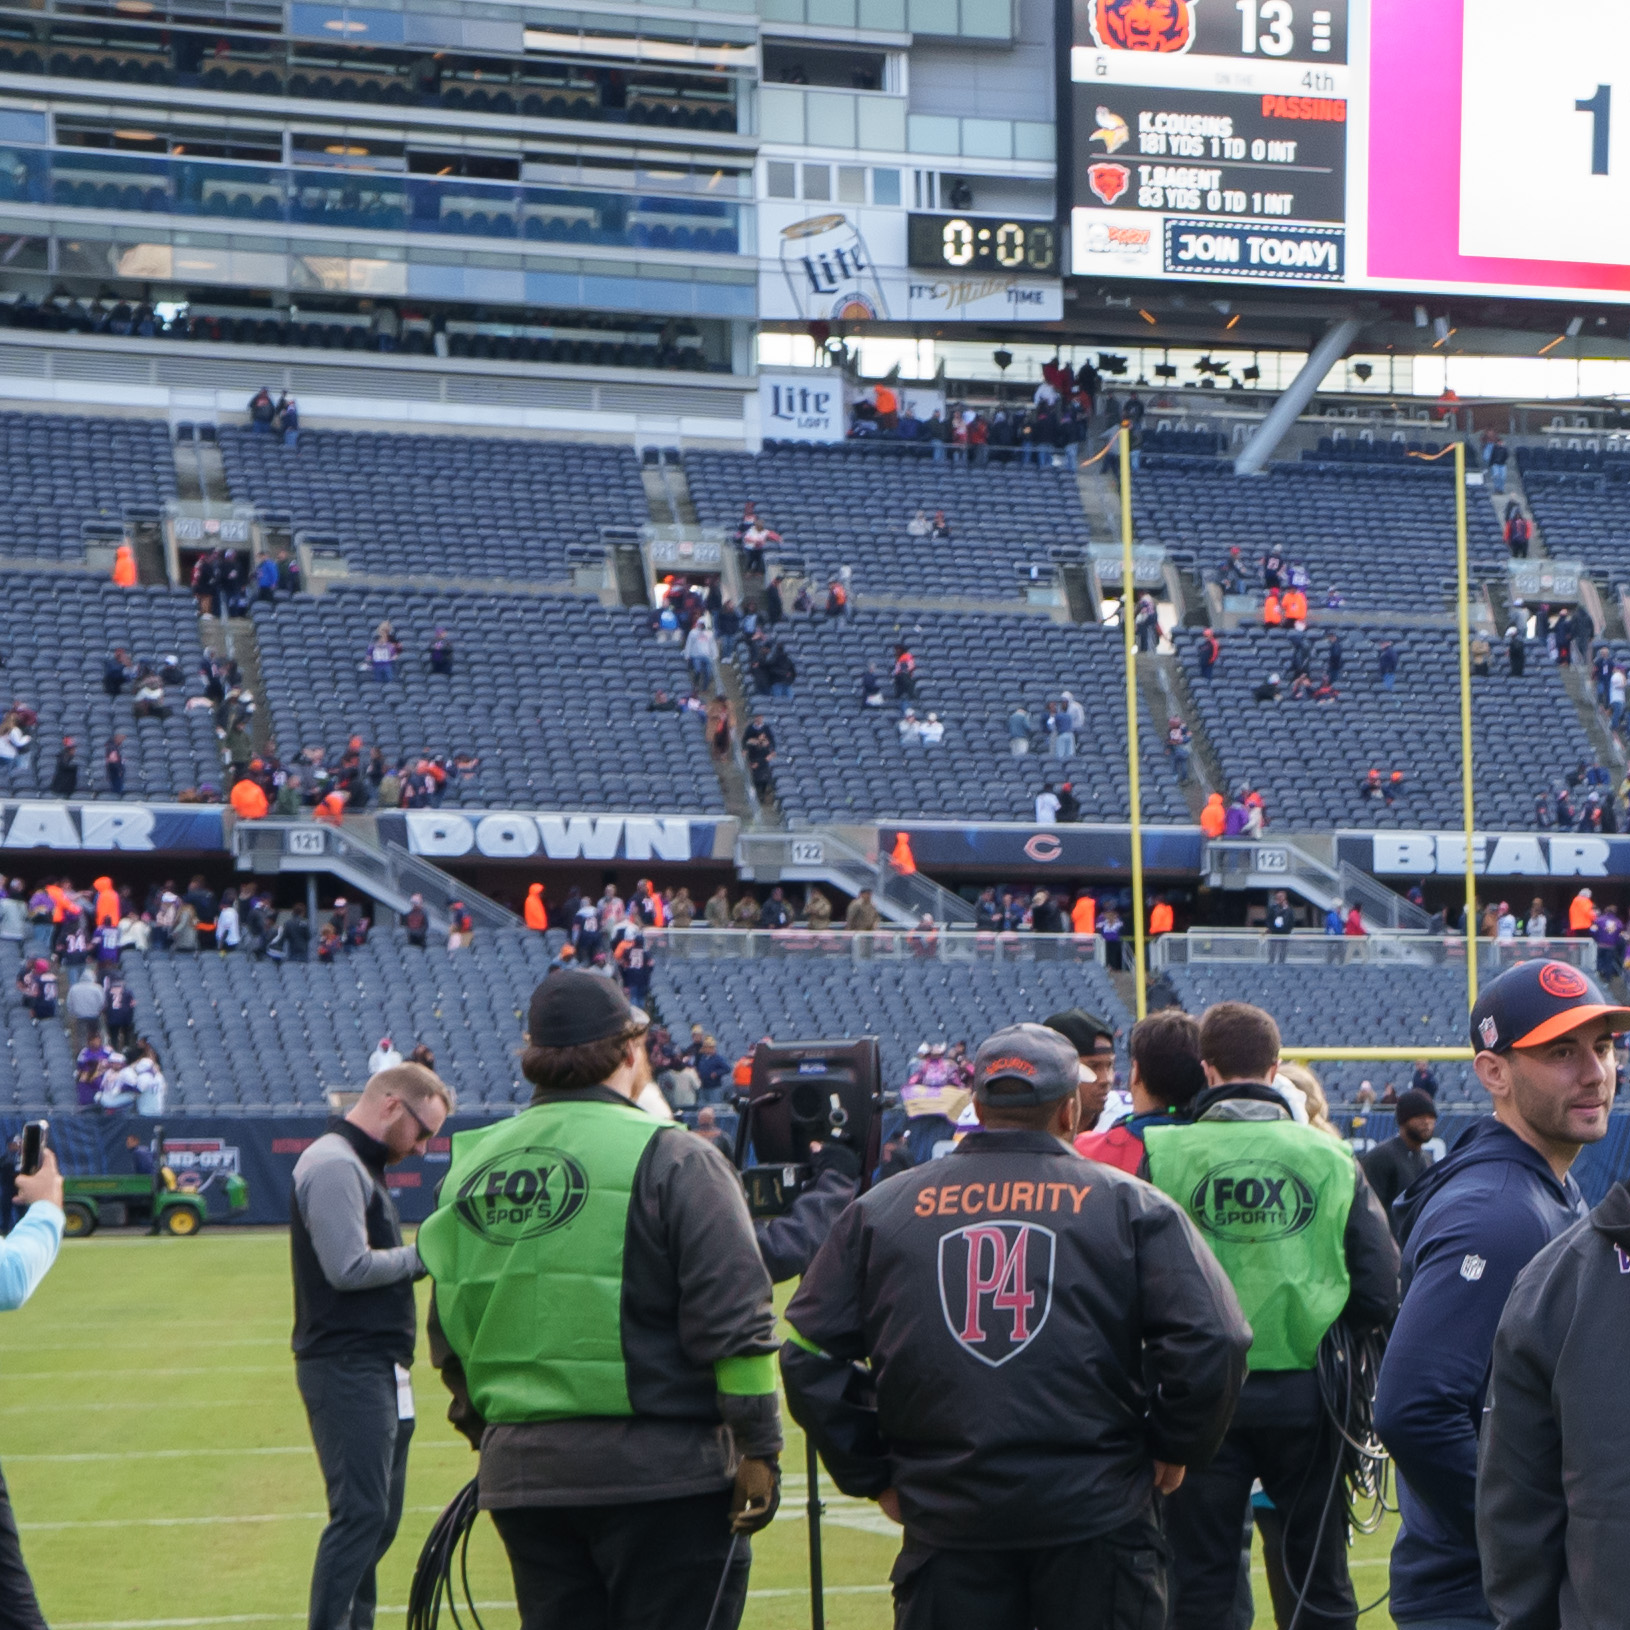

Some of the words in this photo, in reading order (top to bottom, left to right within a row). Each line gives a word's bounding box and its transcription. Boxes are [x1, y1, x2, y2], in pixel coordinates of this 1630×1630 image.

[1236, 0, 1294, 56] 13
[1301, 70, 1335, 92] 4th
[1138, 111, 1233, 138] K.COUSINS
[1262, 94, 1347, 122] PASSING
[1169, 135, 1204, 155] YDS
[1210, 137, 1220, 157] 1
[1222, 138, 1246, 159] TD
[1267, 141, 1297, 161] INT
[1166, 188, 1201, 210] YDS
[1222, 191, 1247, 213] TD
[1252, 193, 1262, 214] 1
[1264, 194, 1294, 216] INT
[802, 241, 867, 295] Lite
[1178, 233, 1240, 263] JOIN
[1245, 236, 1338, 272] TODAY!
[1006, 288, 1044, 304] TIME
[770, 384, 831, 421] Lite
[0, 803, 156, 850] AR
[291, 831, 322, 850] 121
[404, 812, 692, 862] DOWN
[792, 842, 823, 860] 122
[1258, 852, 1286, 867] 123
[1373, 833, 1611, 877] BEAR
[485, 1164, 559, 1209] FOX
[914, 1181, 1092, 1218] SECURITY
[1212, 1177, 1288, 1211] FOX
[486, 1203, 552, 1226] SPORS
[960, 1225, 1035, 1342] P4
